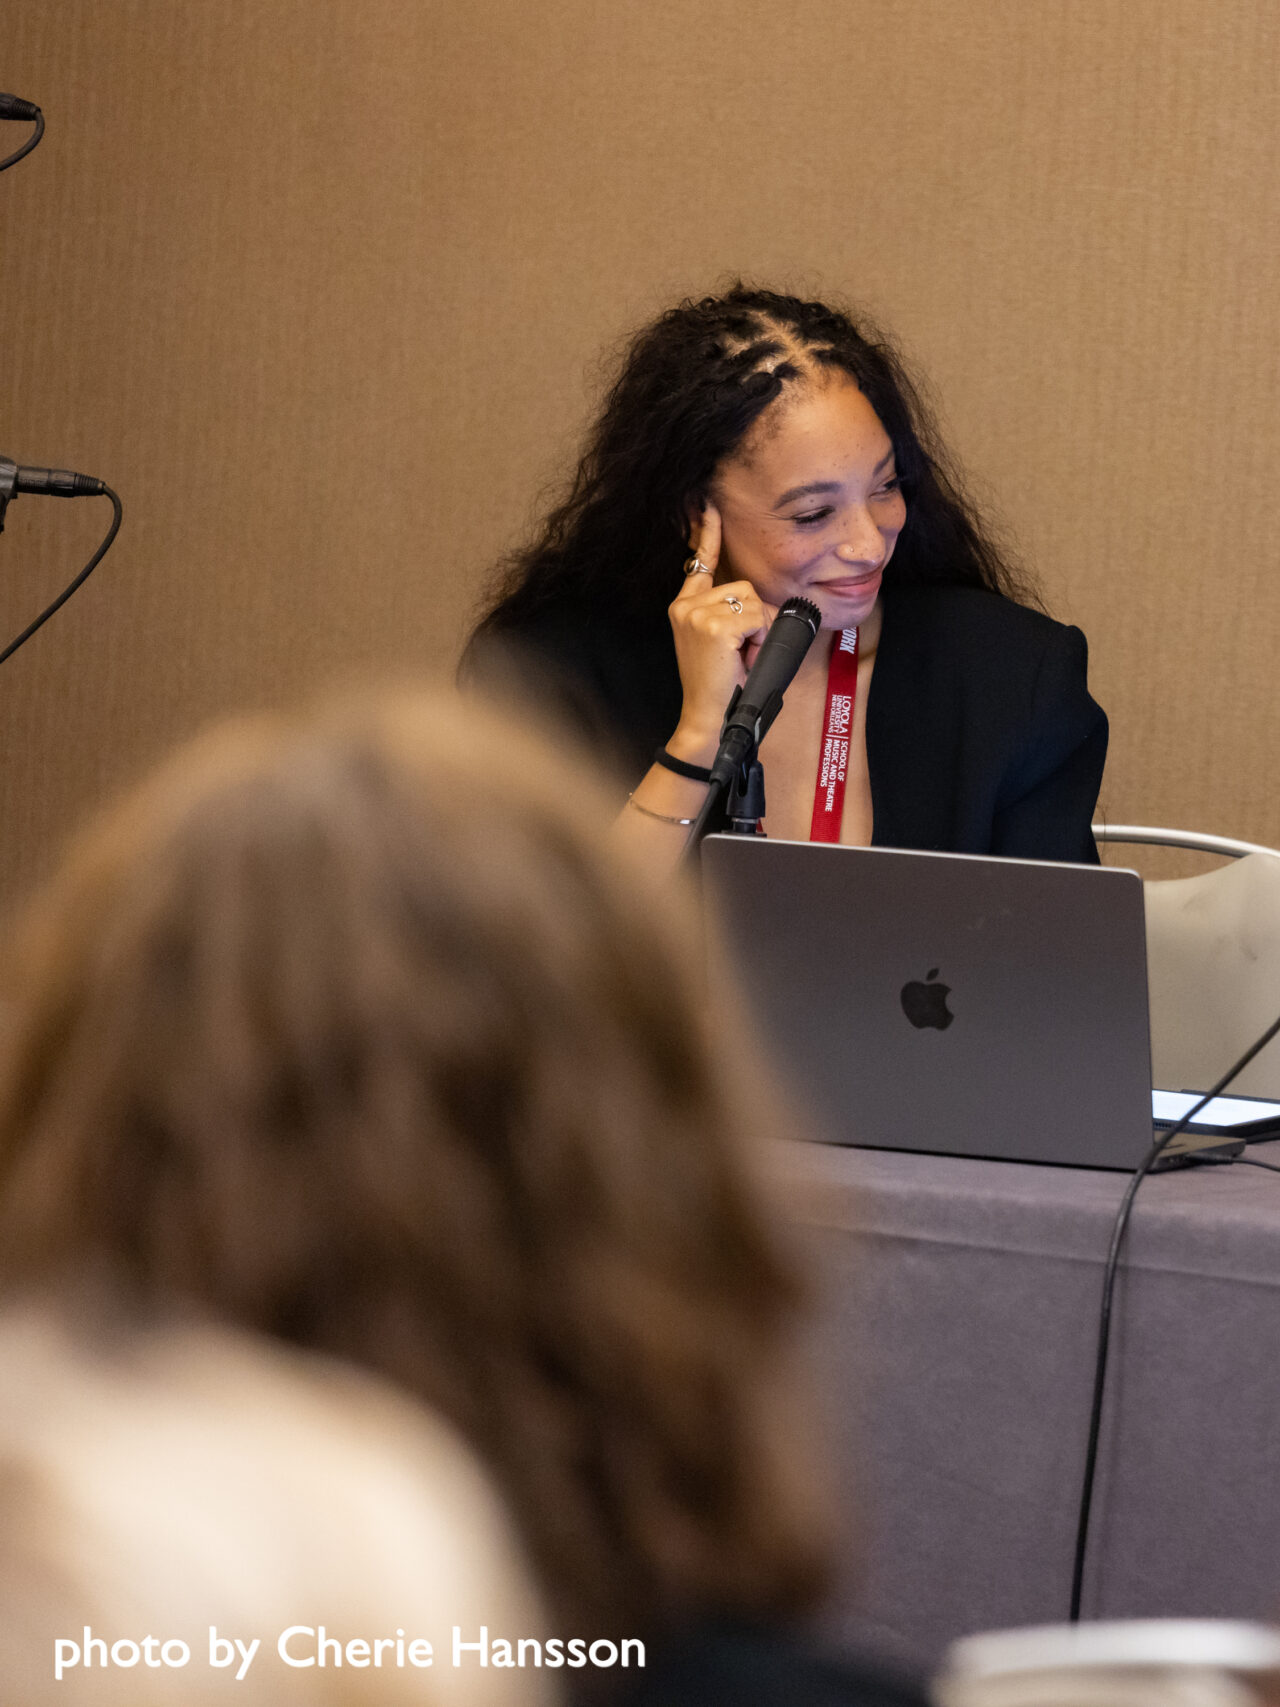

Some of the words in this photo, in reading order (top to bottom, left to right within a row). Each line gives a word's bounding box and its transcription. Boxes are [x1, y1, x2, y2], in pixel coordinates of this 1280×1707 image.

[833, 695, 843, 734] UNIVERSITY
[839, 695, 852, 734] LOYOLA
[820, 738, 833, 788] PROFESSIONS
[831, 739, 841, 764] MUSIC
[838, 740, 849, 771] SCHOOL
[828, 763, 837, 781] AND
[837, 771, 845, 782] OF
[825, 780, 836, 813] THEATRE
